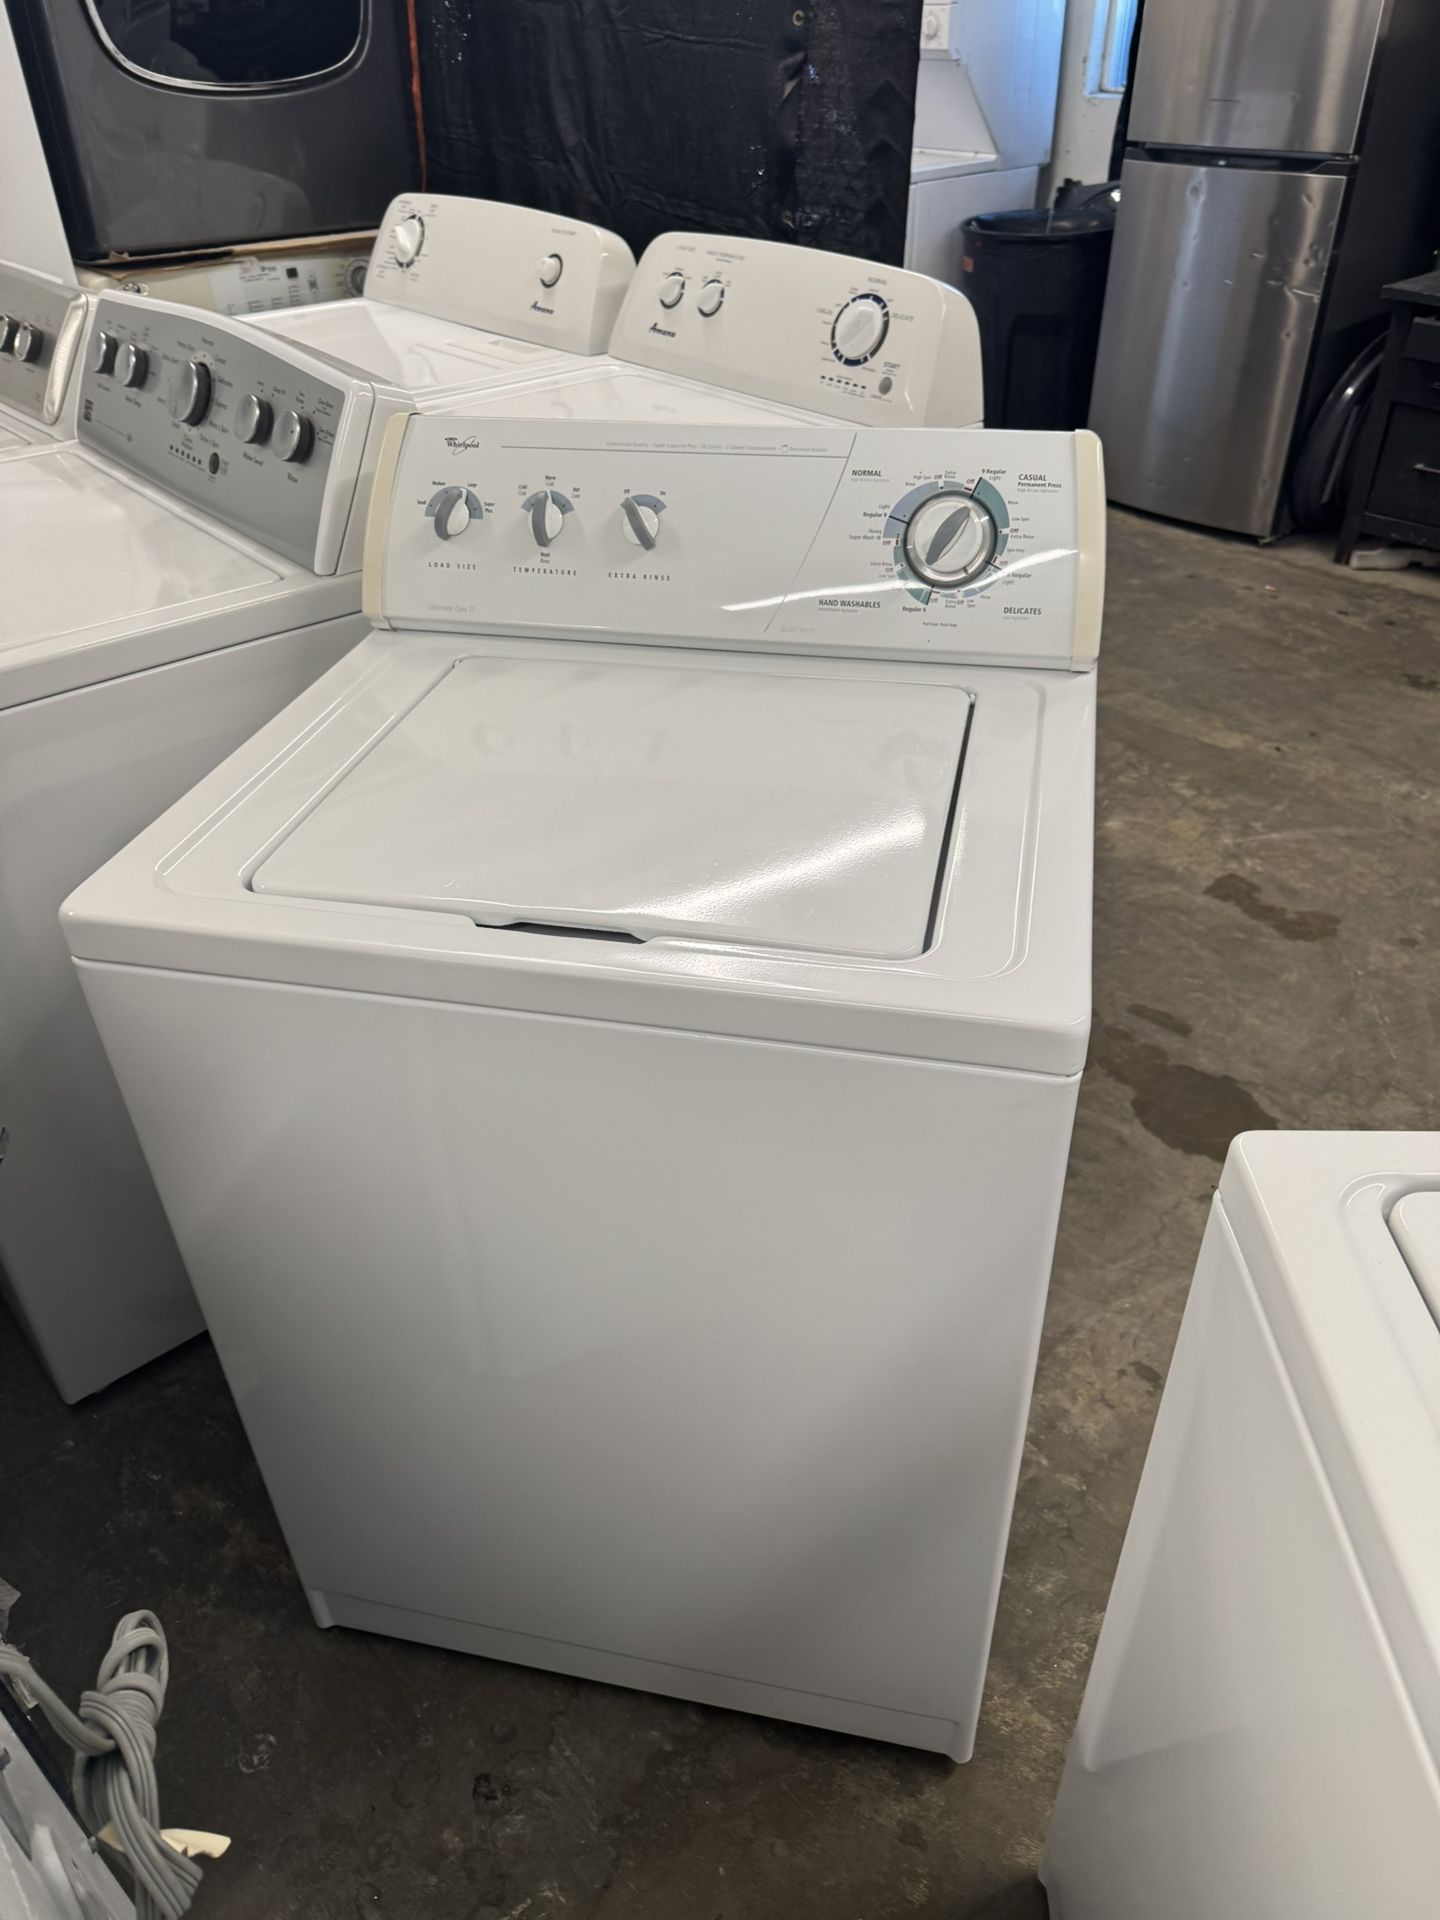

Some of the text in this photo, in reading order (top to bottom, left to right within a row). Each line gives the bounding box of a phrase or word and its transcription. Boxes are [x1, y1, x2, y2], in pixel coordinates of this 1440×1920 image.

[531, 301, 554, 315] Amana
[649, 322, 676, 338] Amana
[446, 438, 480, 451] Whirlpool
[852, 469, 882, 478] NORMAL
[986, 468, 1008, 476] Regular
[1018, 473, 1048, 482] CASUAL
[1017, 481, 1047, 489] Permanent
[863, 511, 882, 519] Regular
[427, 561, 476, 571] LOAD SIZE
[513, 566, 577, 577] TEMPERATURE
[608, 571, 671, 582] EXTRA RINSE
[818, 599, 880, 609] HAND WASHABLES
[1003, 606, 1043, 616] DELICATES
